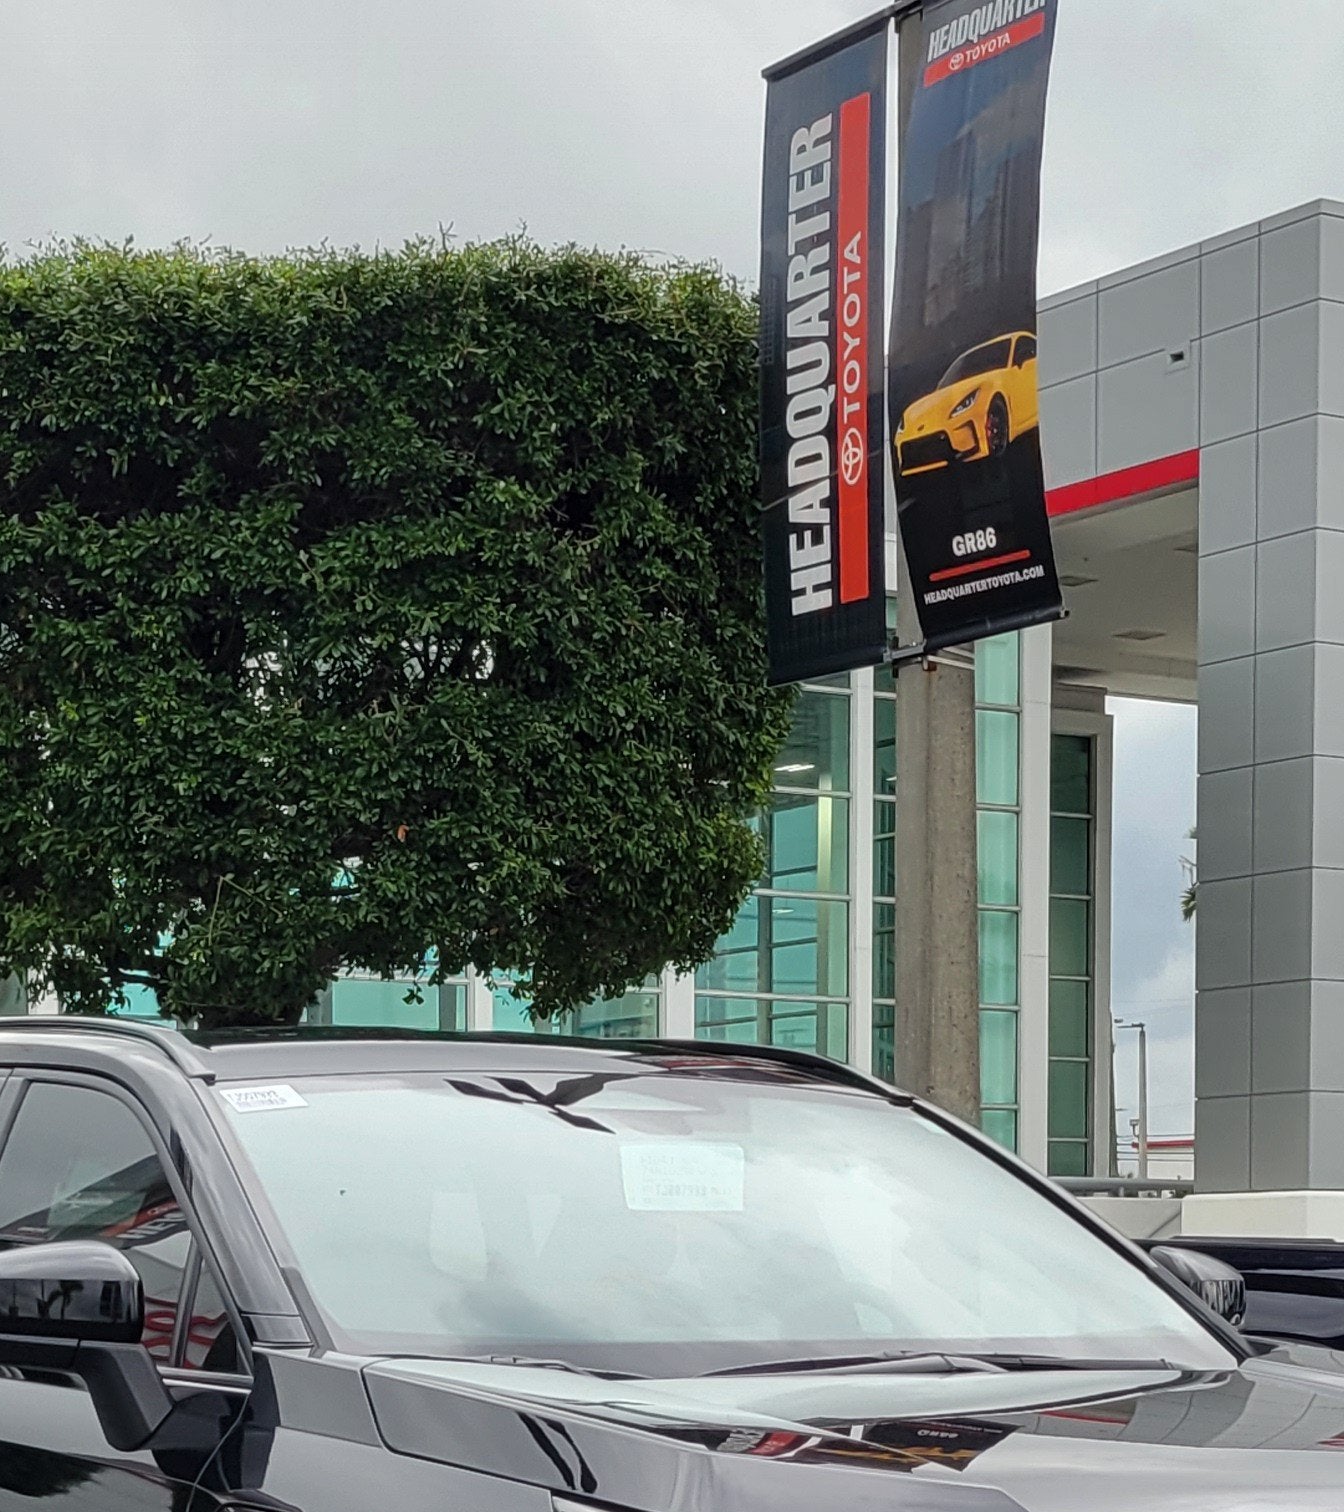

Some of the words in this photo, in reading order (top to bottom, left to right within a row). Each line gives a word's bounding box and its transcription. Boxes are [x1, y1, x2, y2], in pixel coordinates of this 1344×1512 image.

[927, 0, 1046, 63] HEADQUART
[966, 33, 1010, 63] TOYOTA
[843, 231, 862, 422] TOYOTA
[786, 113, 835, 616] HEADQUARTER
[952, 527, 997, 557] GR86
[924, 564, 1045, 605] HEADQUARTERTOYOTA.COM
